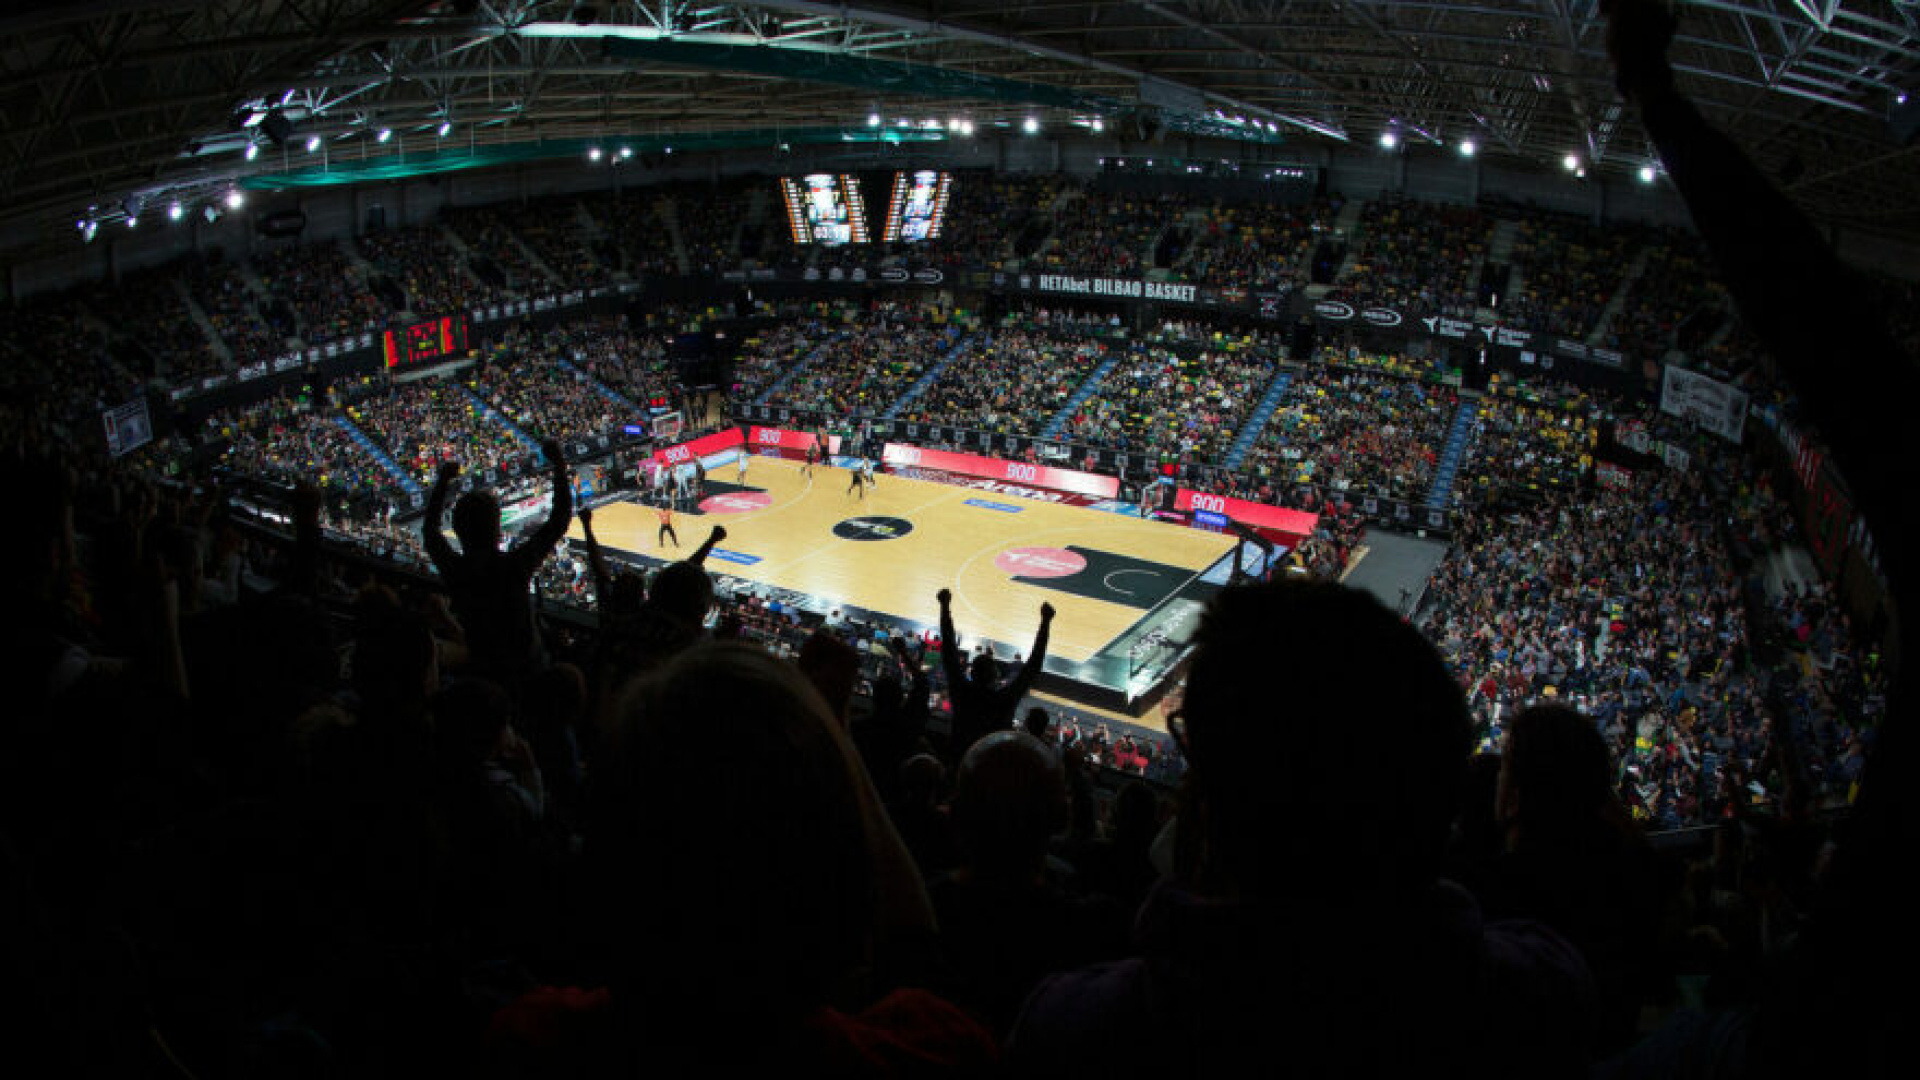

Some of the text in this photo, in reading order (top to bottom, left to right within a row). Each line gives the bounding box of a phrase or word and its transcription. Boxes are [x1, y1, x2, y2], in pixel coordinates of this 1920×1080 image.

[1094, 279, 1141, 297] BILBAO
[1145, 283, 1196, 301] BASKET
[1007, 462, 1036, 481] 900
[1191, 493, 1224, 513] 900
